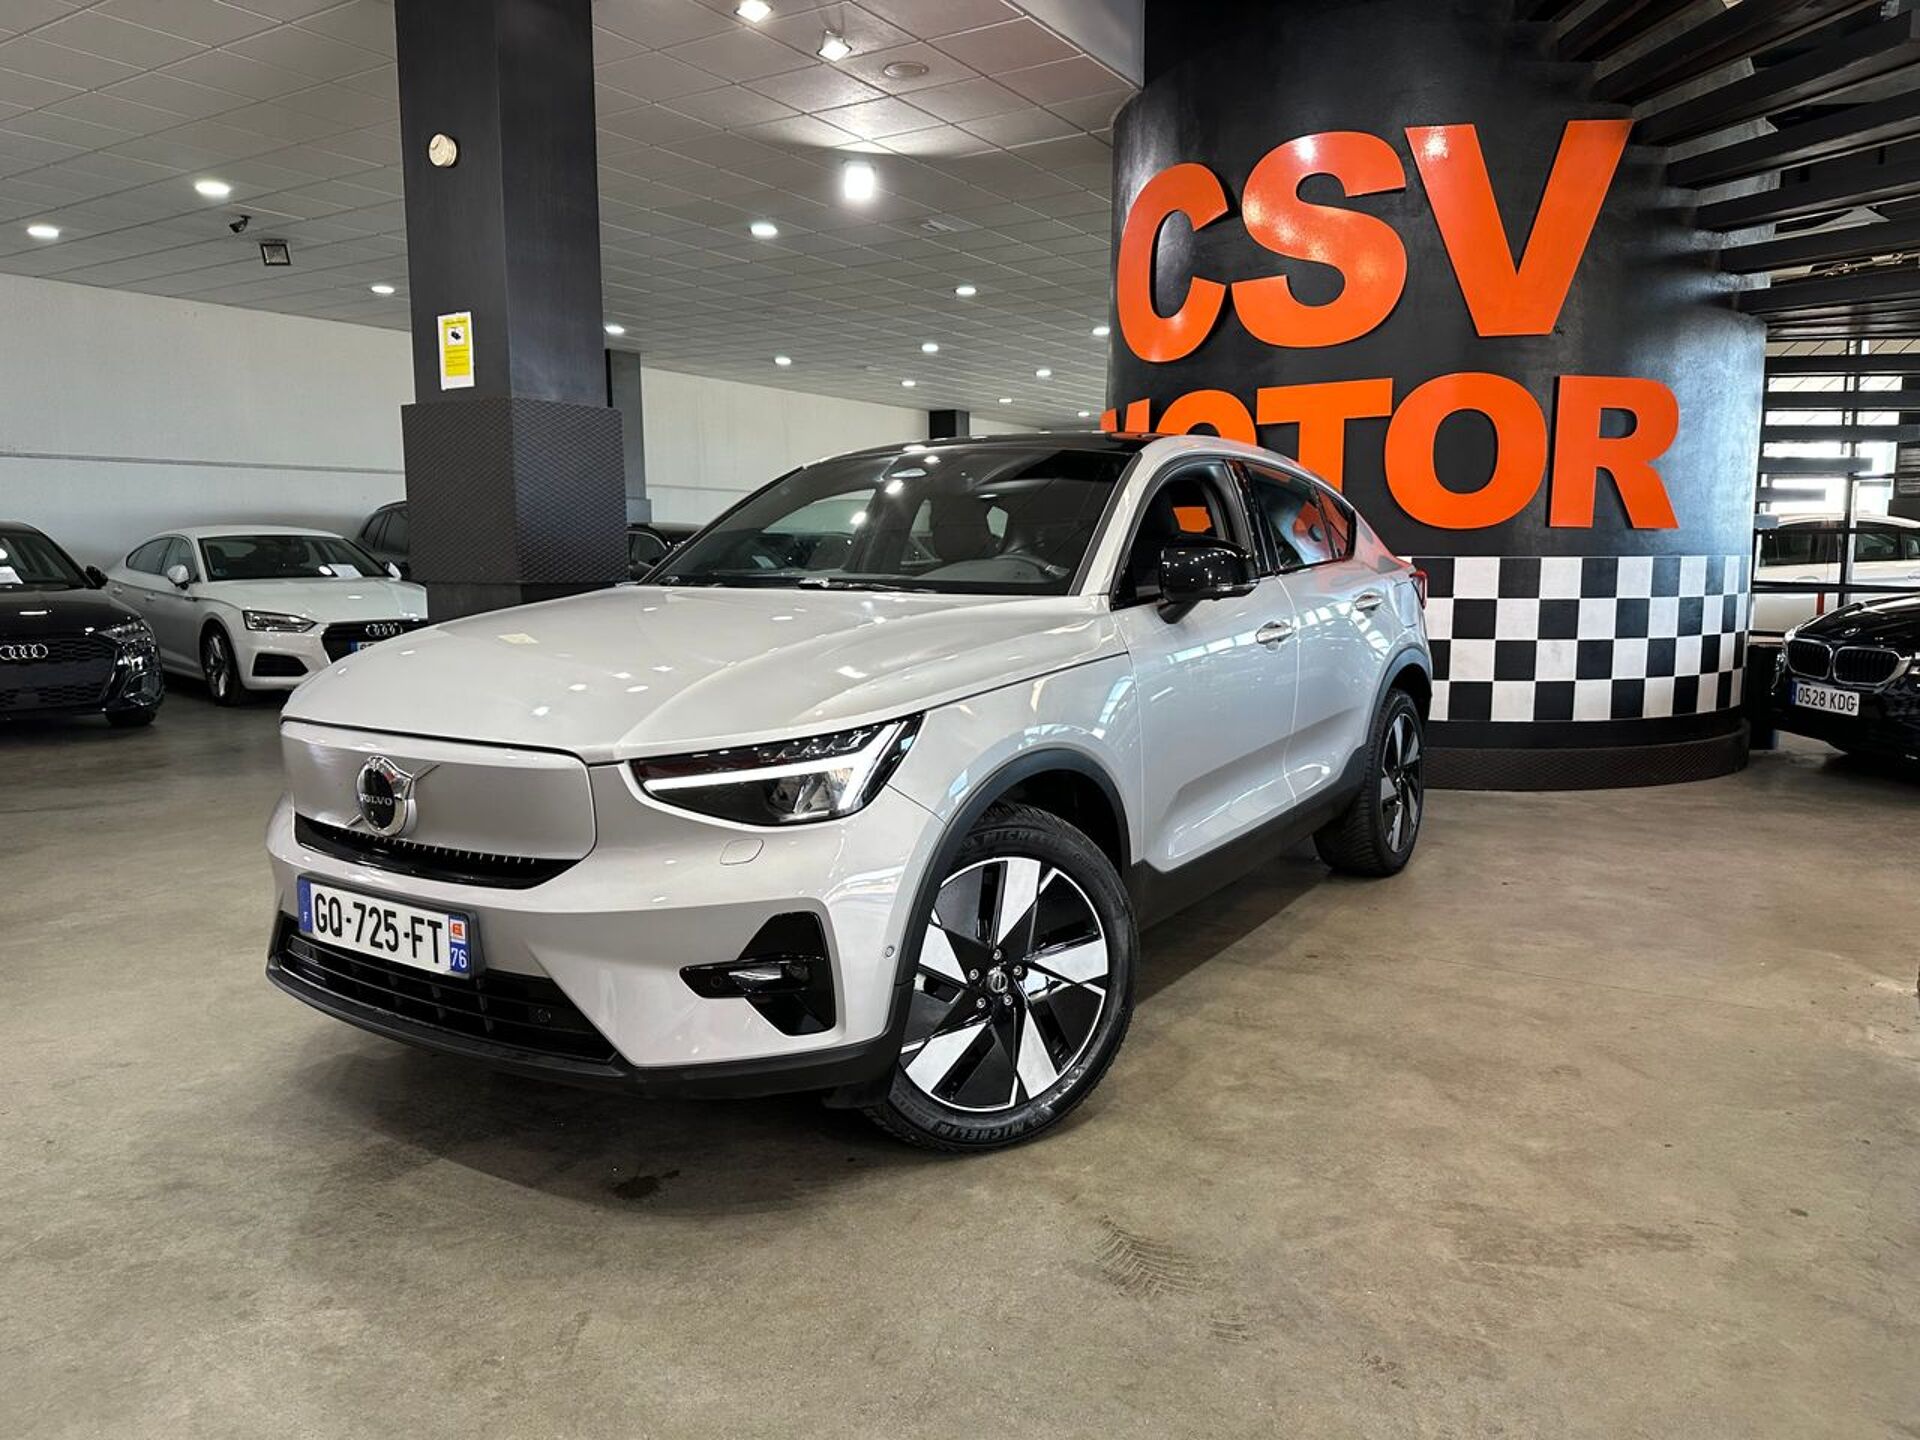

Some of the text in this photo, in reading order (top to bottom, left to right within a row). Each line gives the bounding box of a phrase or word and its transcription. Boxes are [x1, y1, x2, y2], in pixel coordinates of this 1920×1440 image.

[1117, 119, 1635, 363] CSV
[1798, 687, 1857, 712] 0528 KDG
[314, 892, 443, 964] GQ-725-FT
[451, 947, 467, 969] 76
